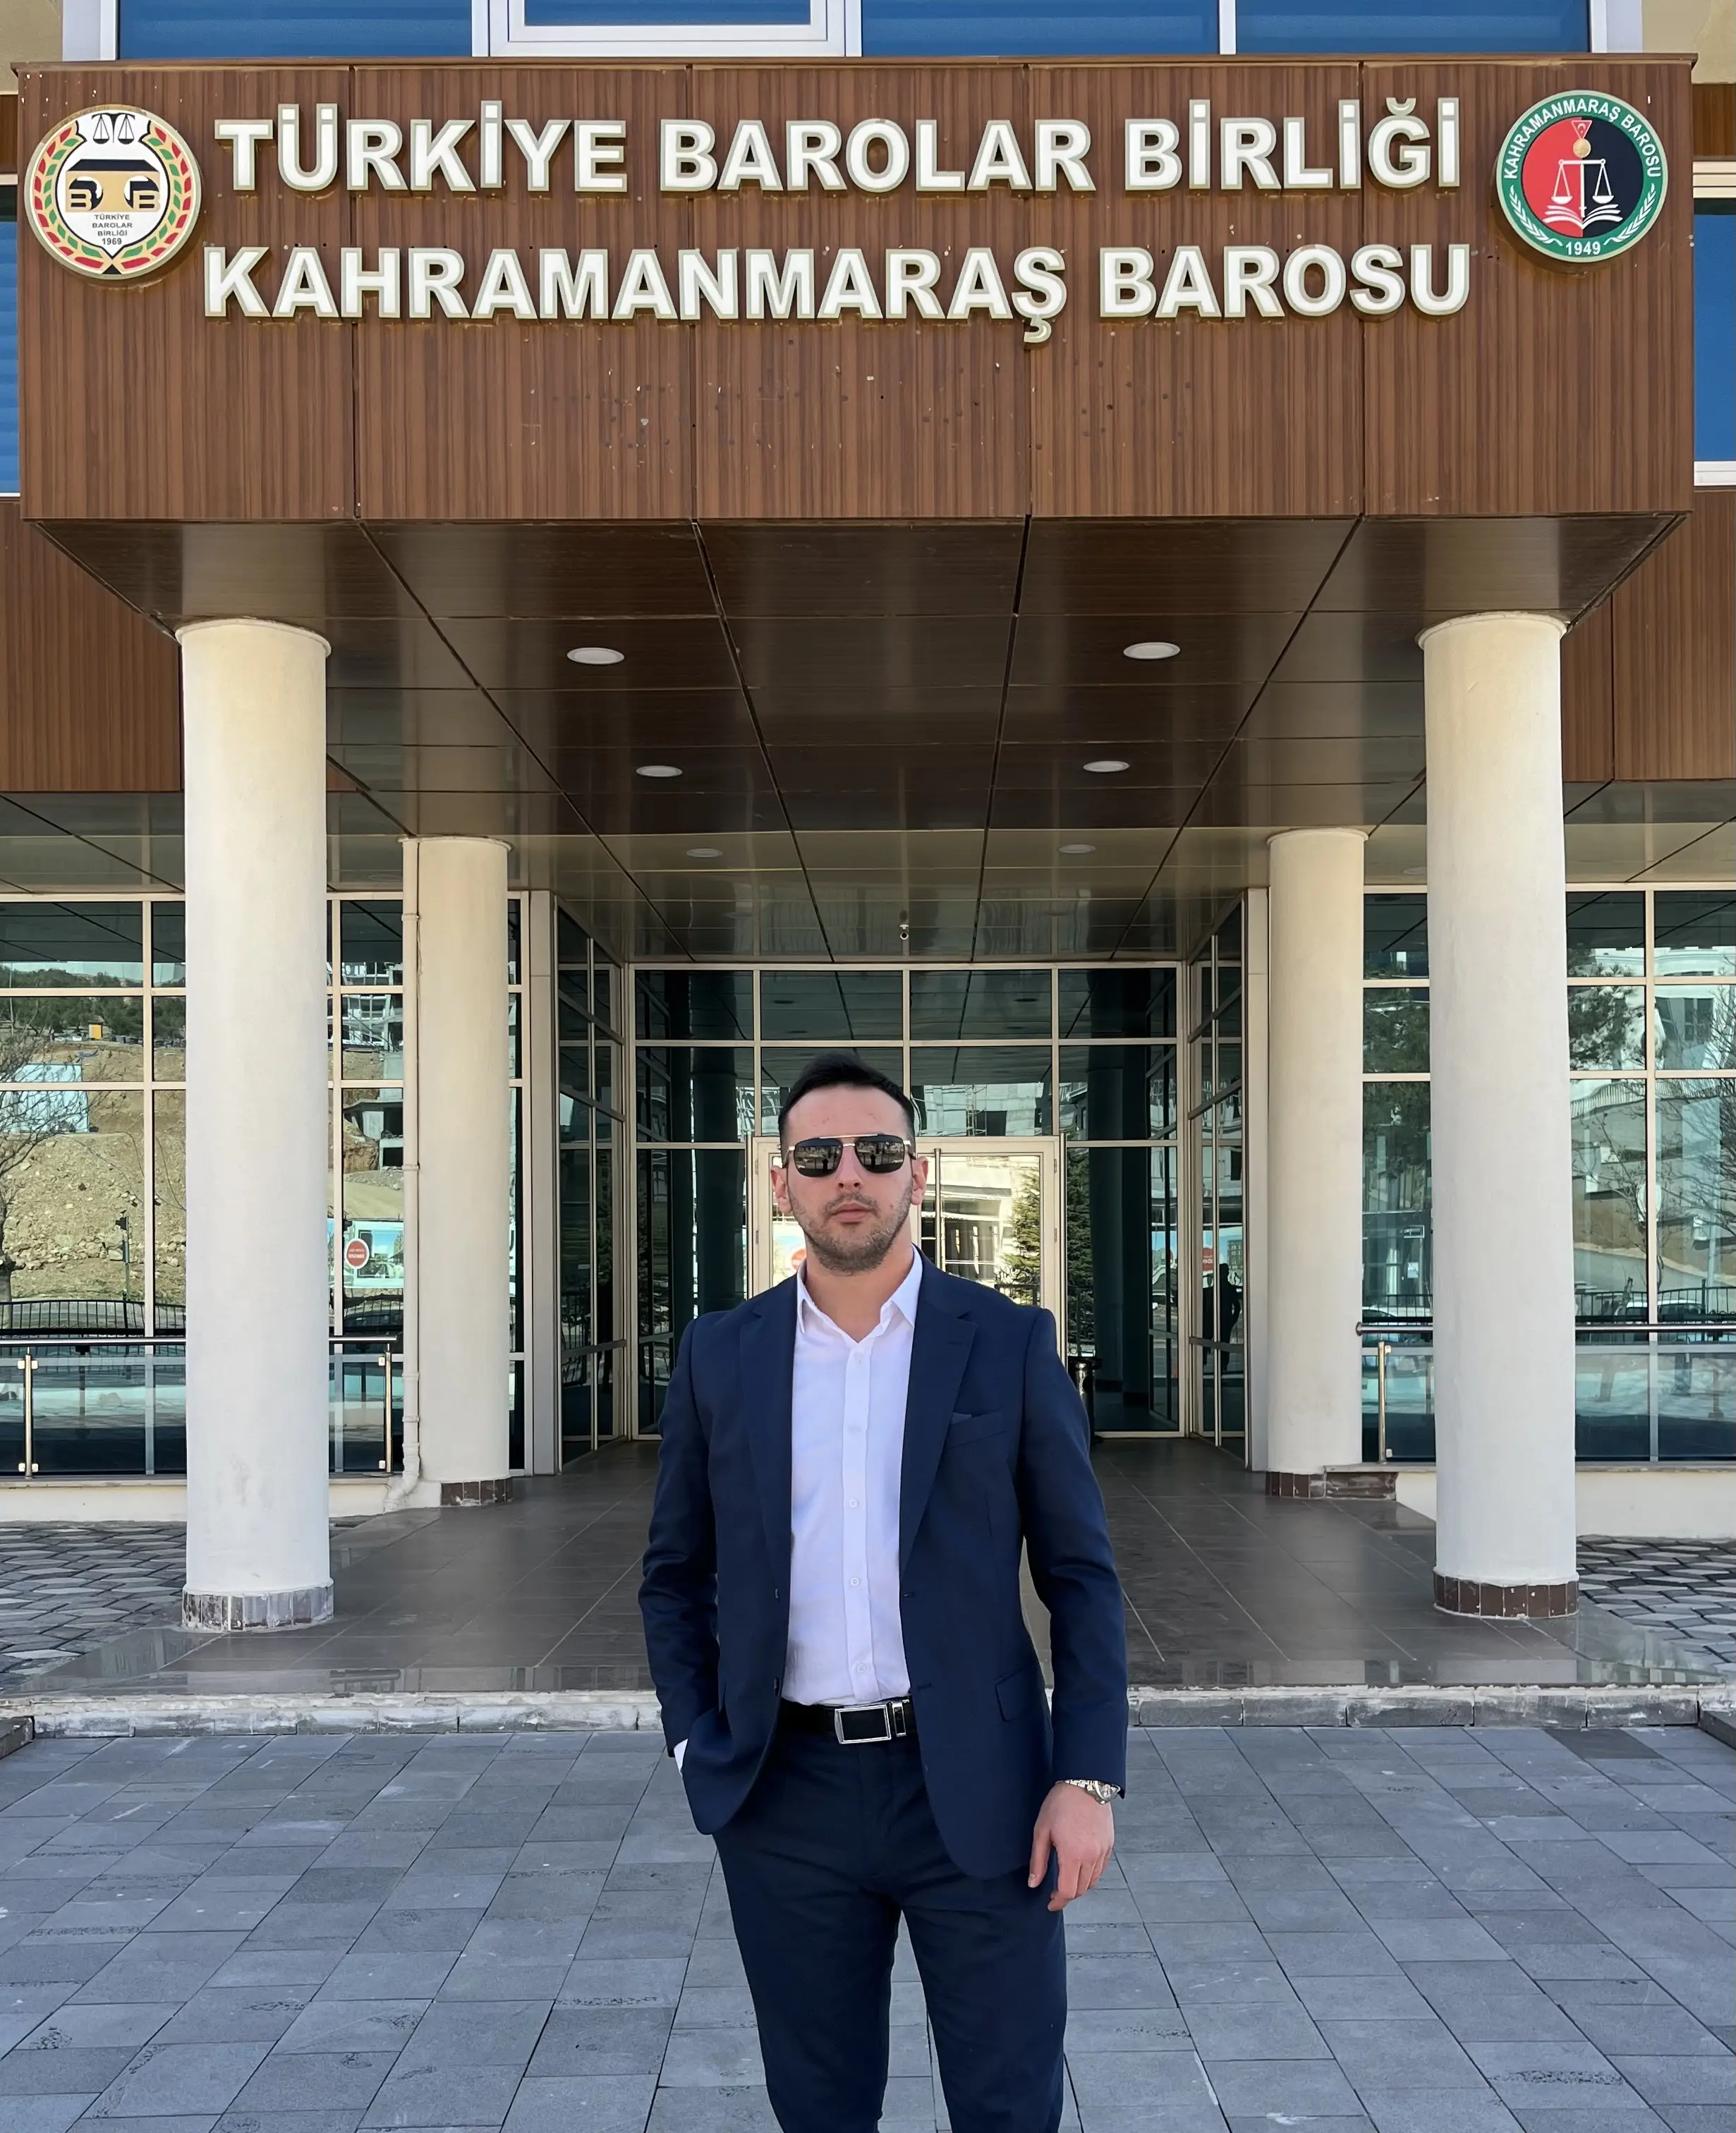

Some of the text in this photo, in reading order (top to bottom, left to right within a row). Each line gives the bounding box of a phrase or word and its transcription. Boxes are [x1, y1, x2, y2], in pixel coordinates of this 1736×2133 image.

[214, 97, 1460, 193] TÜRKİYE BAROLAR BİRLİĞİ
[1503, 98, 1662, 180] KAHRAMANMARAŞ BAROSU
[1565, 241, 1601, 256] 1949
[203, 243, 1471, 344] KAHRAMANMARAŞ BAROSU
